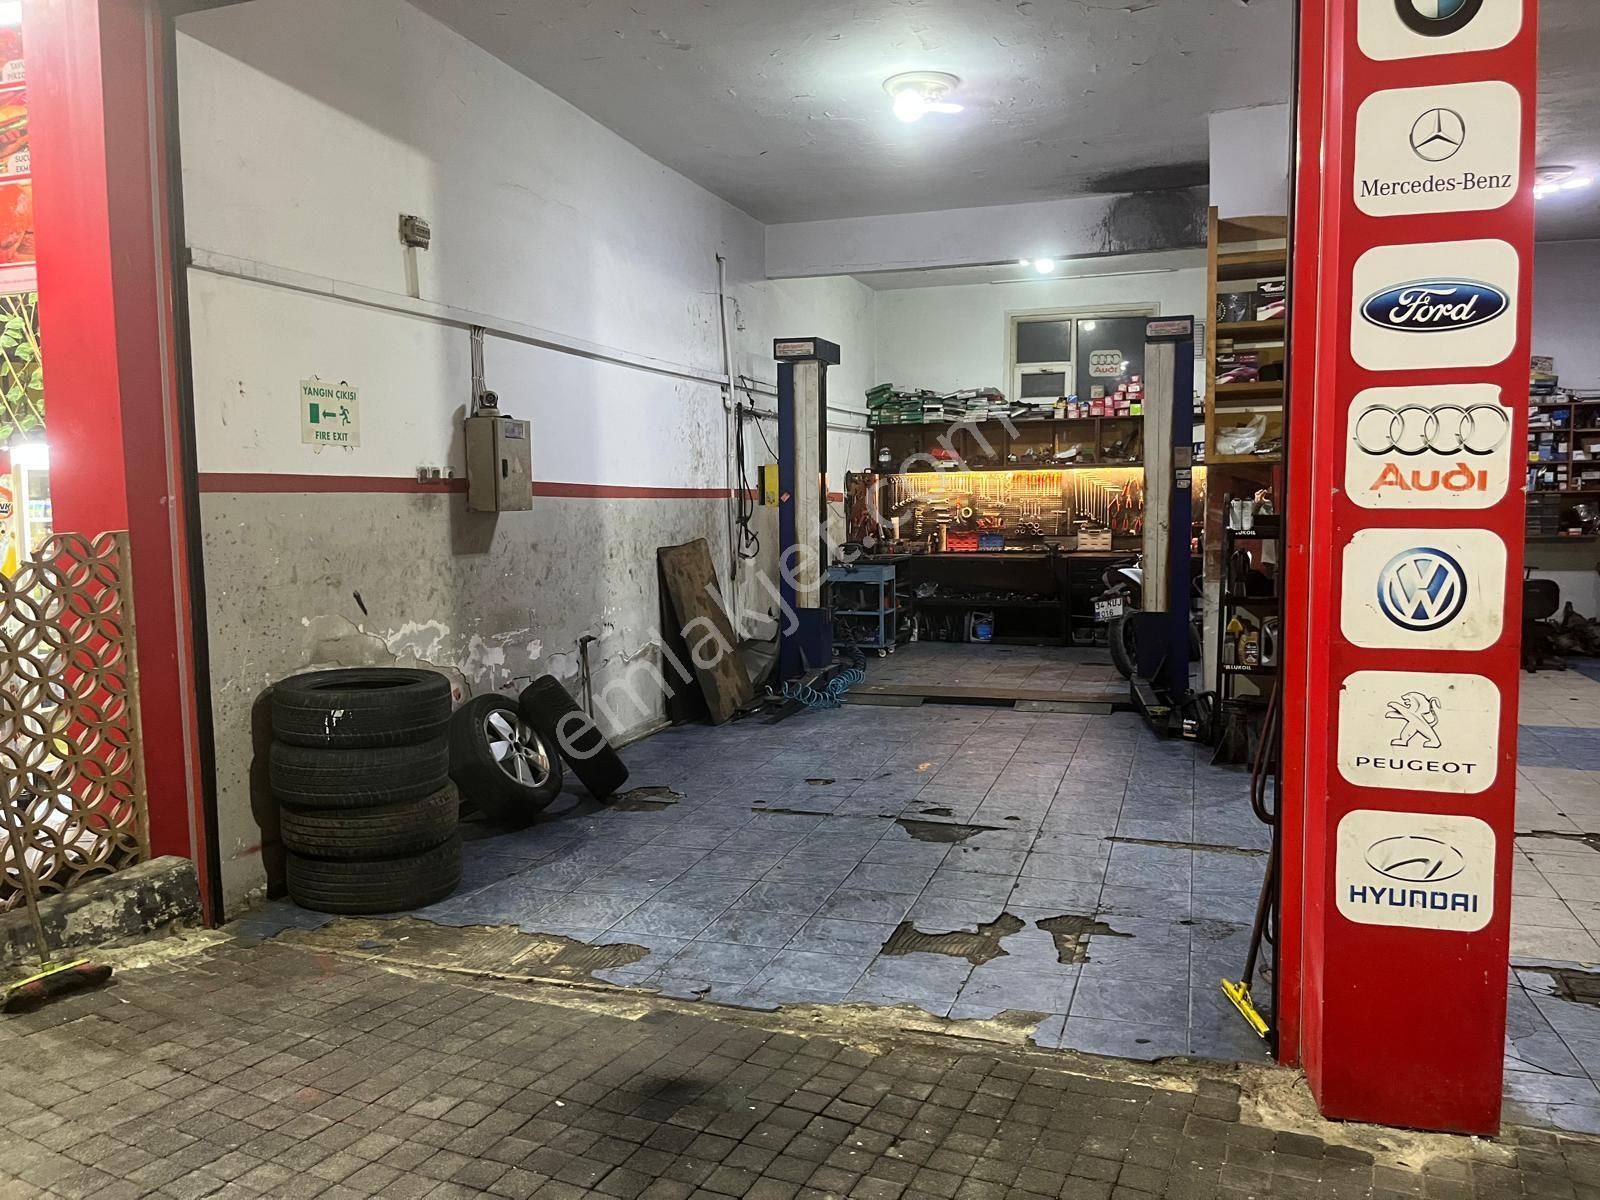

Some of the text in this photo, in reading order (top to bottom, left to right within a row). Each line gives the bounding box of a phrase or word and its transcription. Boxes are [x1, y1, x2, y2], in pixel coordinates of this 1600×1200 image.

[1360, 172, 1512, 198] Mercedes-Benz
[1389, 287, 1480, 324] Ford
[303, 386, 357, 402] YANGIN ÇIKIŞI
[315, 430, 348, 442] FIRE EXIT
[1356, 756, 1477, 774] PEUGEOT
[1350, 885, 1478, 913] HYUNDAI
